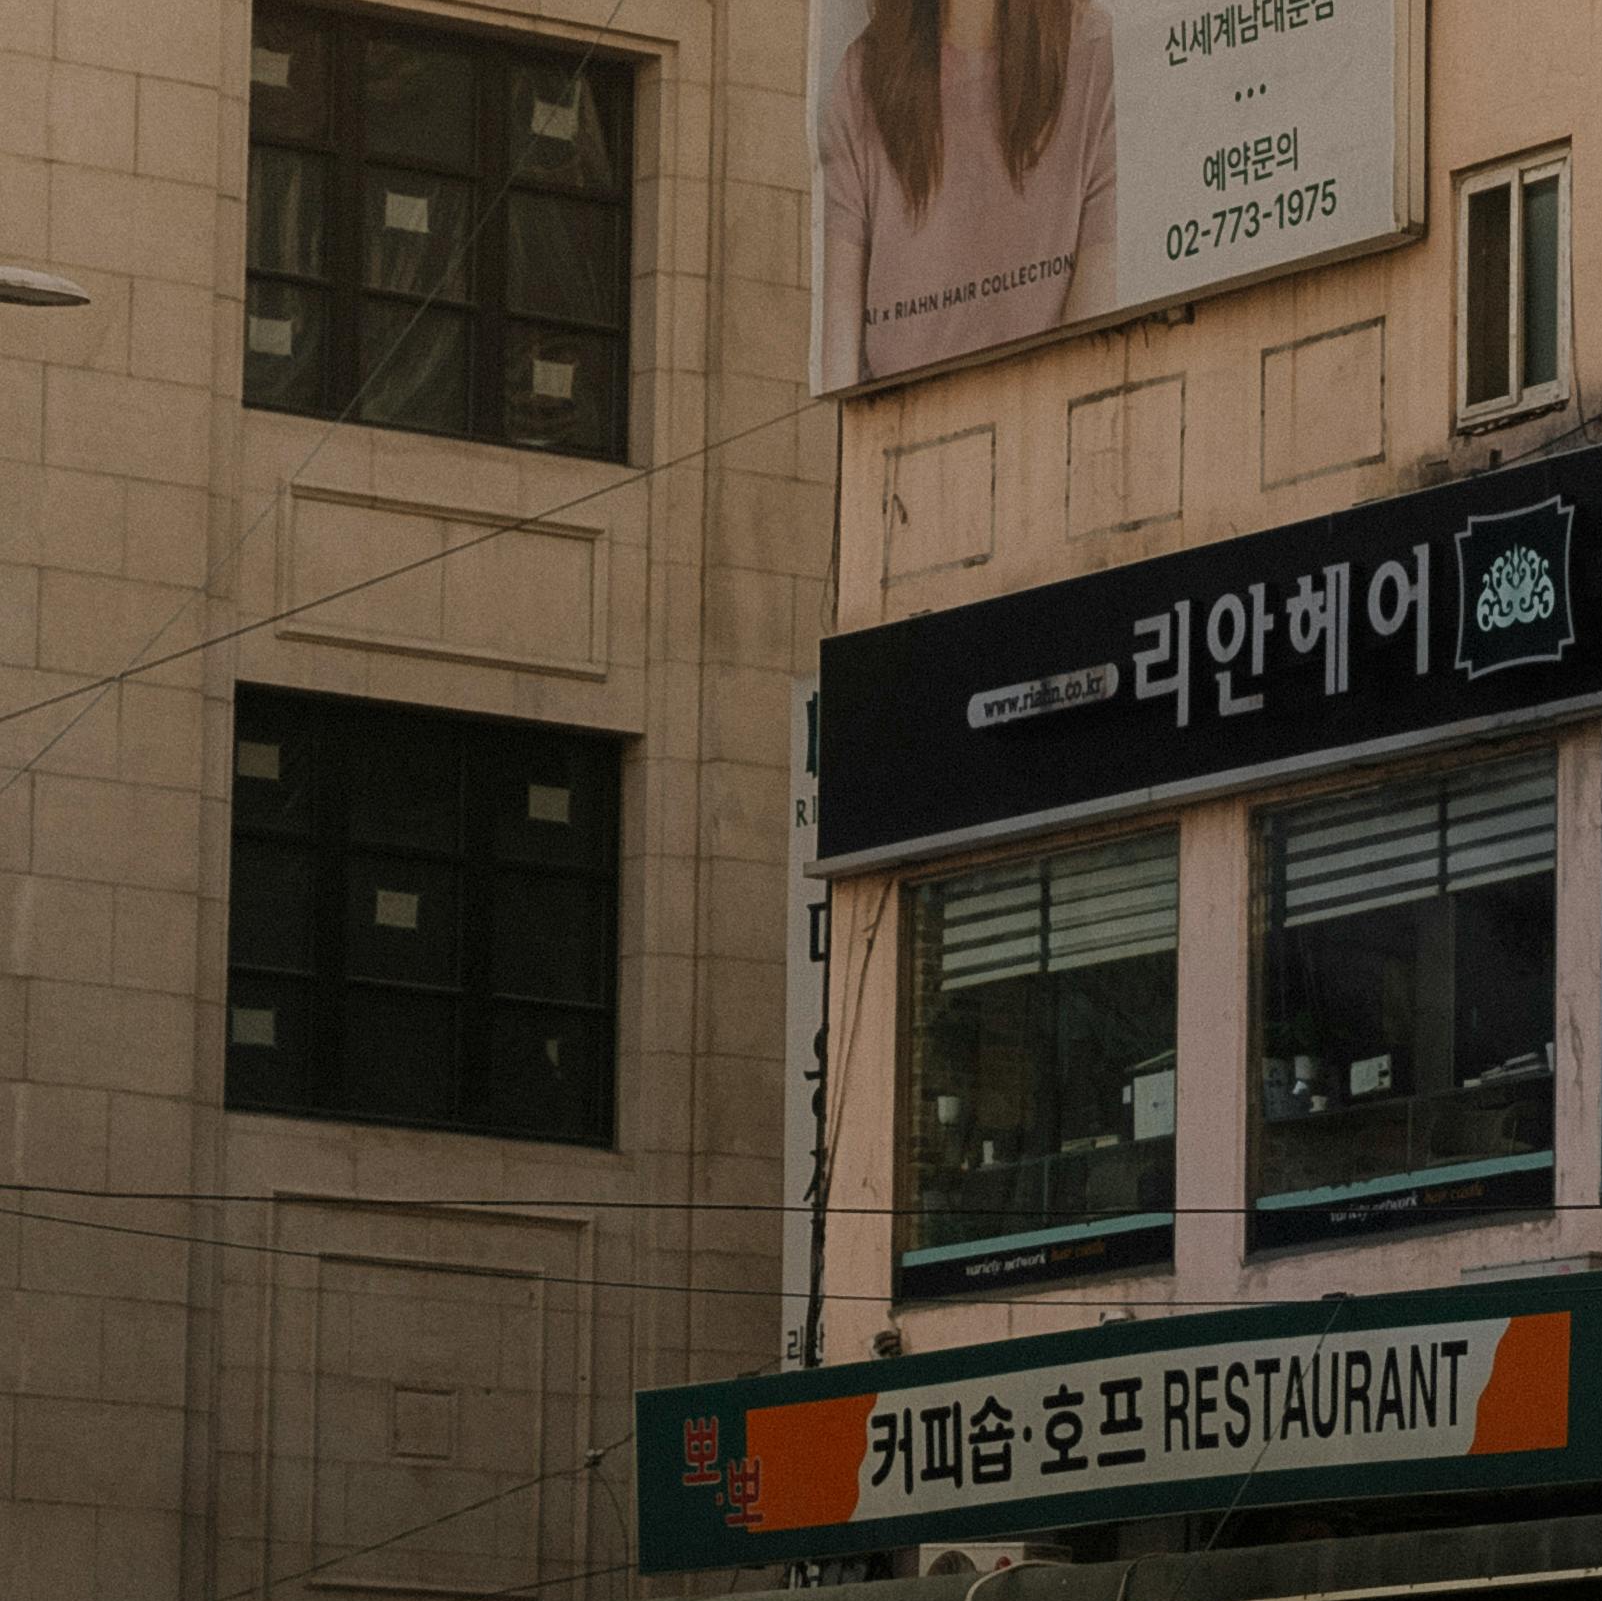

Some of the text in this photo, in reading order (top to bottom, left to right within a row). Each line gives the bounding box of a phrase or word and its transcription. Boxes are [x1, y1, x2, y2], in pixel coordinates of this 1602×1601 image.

[1202, 127, 1300, 192] 예약문의
[1166, 179, 1338, 262] 02-773-1975
[895, 295, 938, 319] RIAHN
[942, 283, 976, 309] HAIR
[981, 253, 1076, 296] COLLECTION
[1132, 542, 1430, 728] 리안헤어
[1164, 1338, 1469, 1456] RESTAURANT
